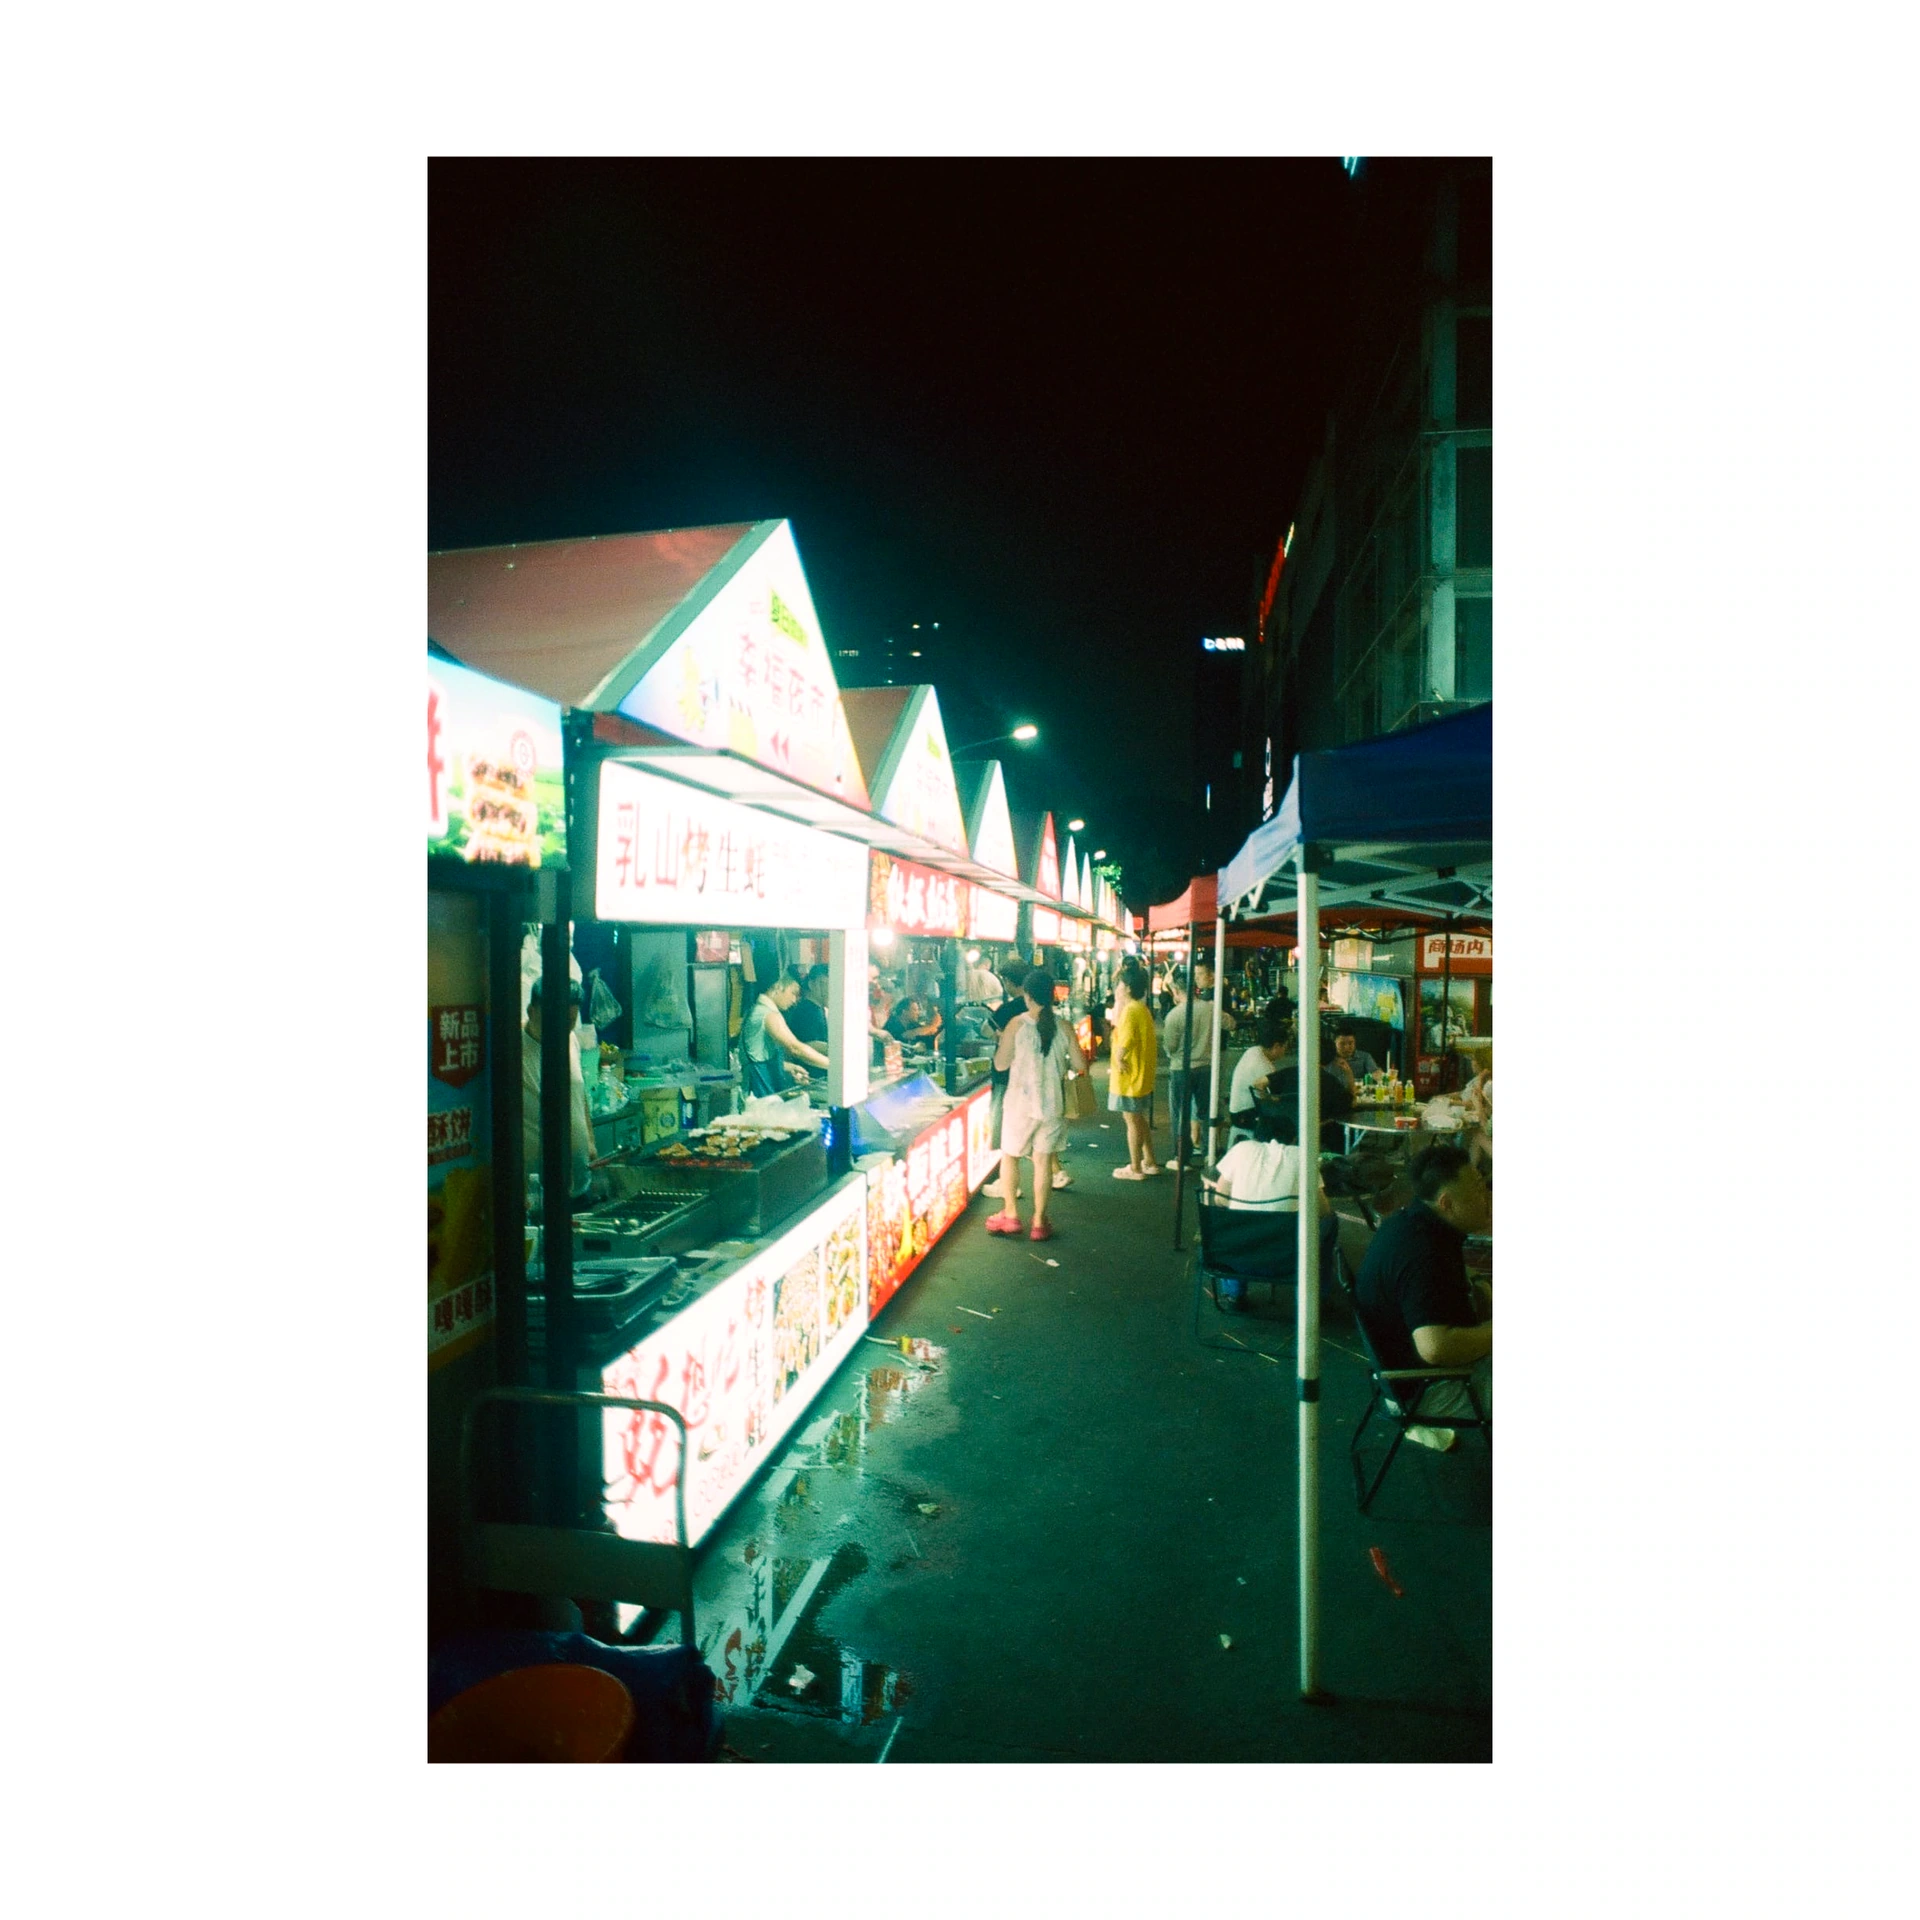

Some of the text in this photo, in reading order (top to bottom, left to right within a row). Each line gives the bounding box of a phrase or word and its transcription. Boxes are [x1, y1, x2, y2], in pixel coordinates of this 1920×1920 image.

[614, 800, 767, 901] 乳山烤生蚝
[438, 1040, 479, 1072] 上市
[440, 1009, 480, 1041] 新品
[743, 1275, 768, 1462] 烤生蚝
